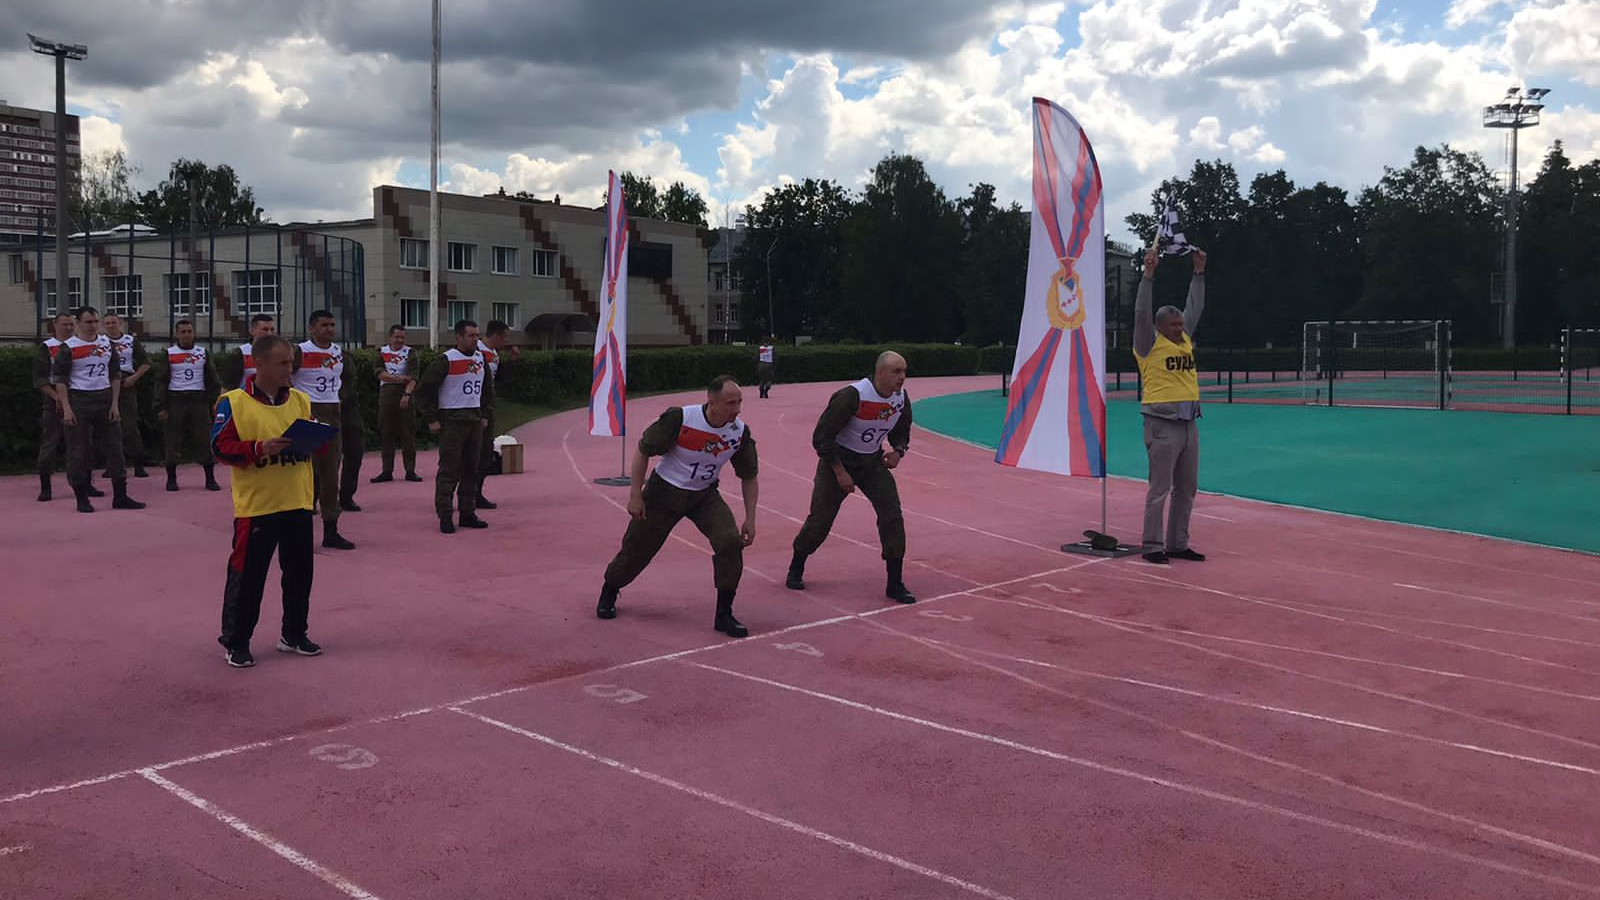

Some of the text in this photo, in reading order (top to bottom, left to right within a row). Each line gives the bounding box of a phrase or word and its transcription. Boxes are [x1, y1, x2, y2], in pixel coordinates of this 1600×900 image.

[86, 363, 105, 377] 72
[184, 368, 194, 381] 9
[315, 376, 336, 392] 31
[463, 380, 481, 395] 65
[861, 427, 888, 444] 67
[689, 462, 717, 481] 13
[584, 684, 648, 704] 5
